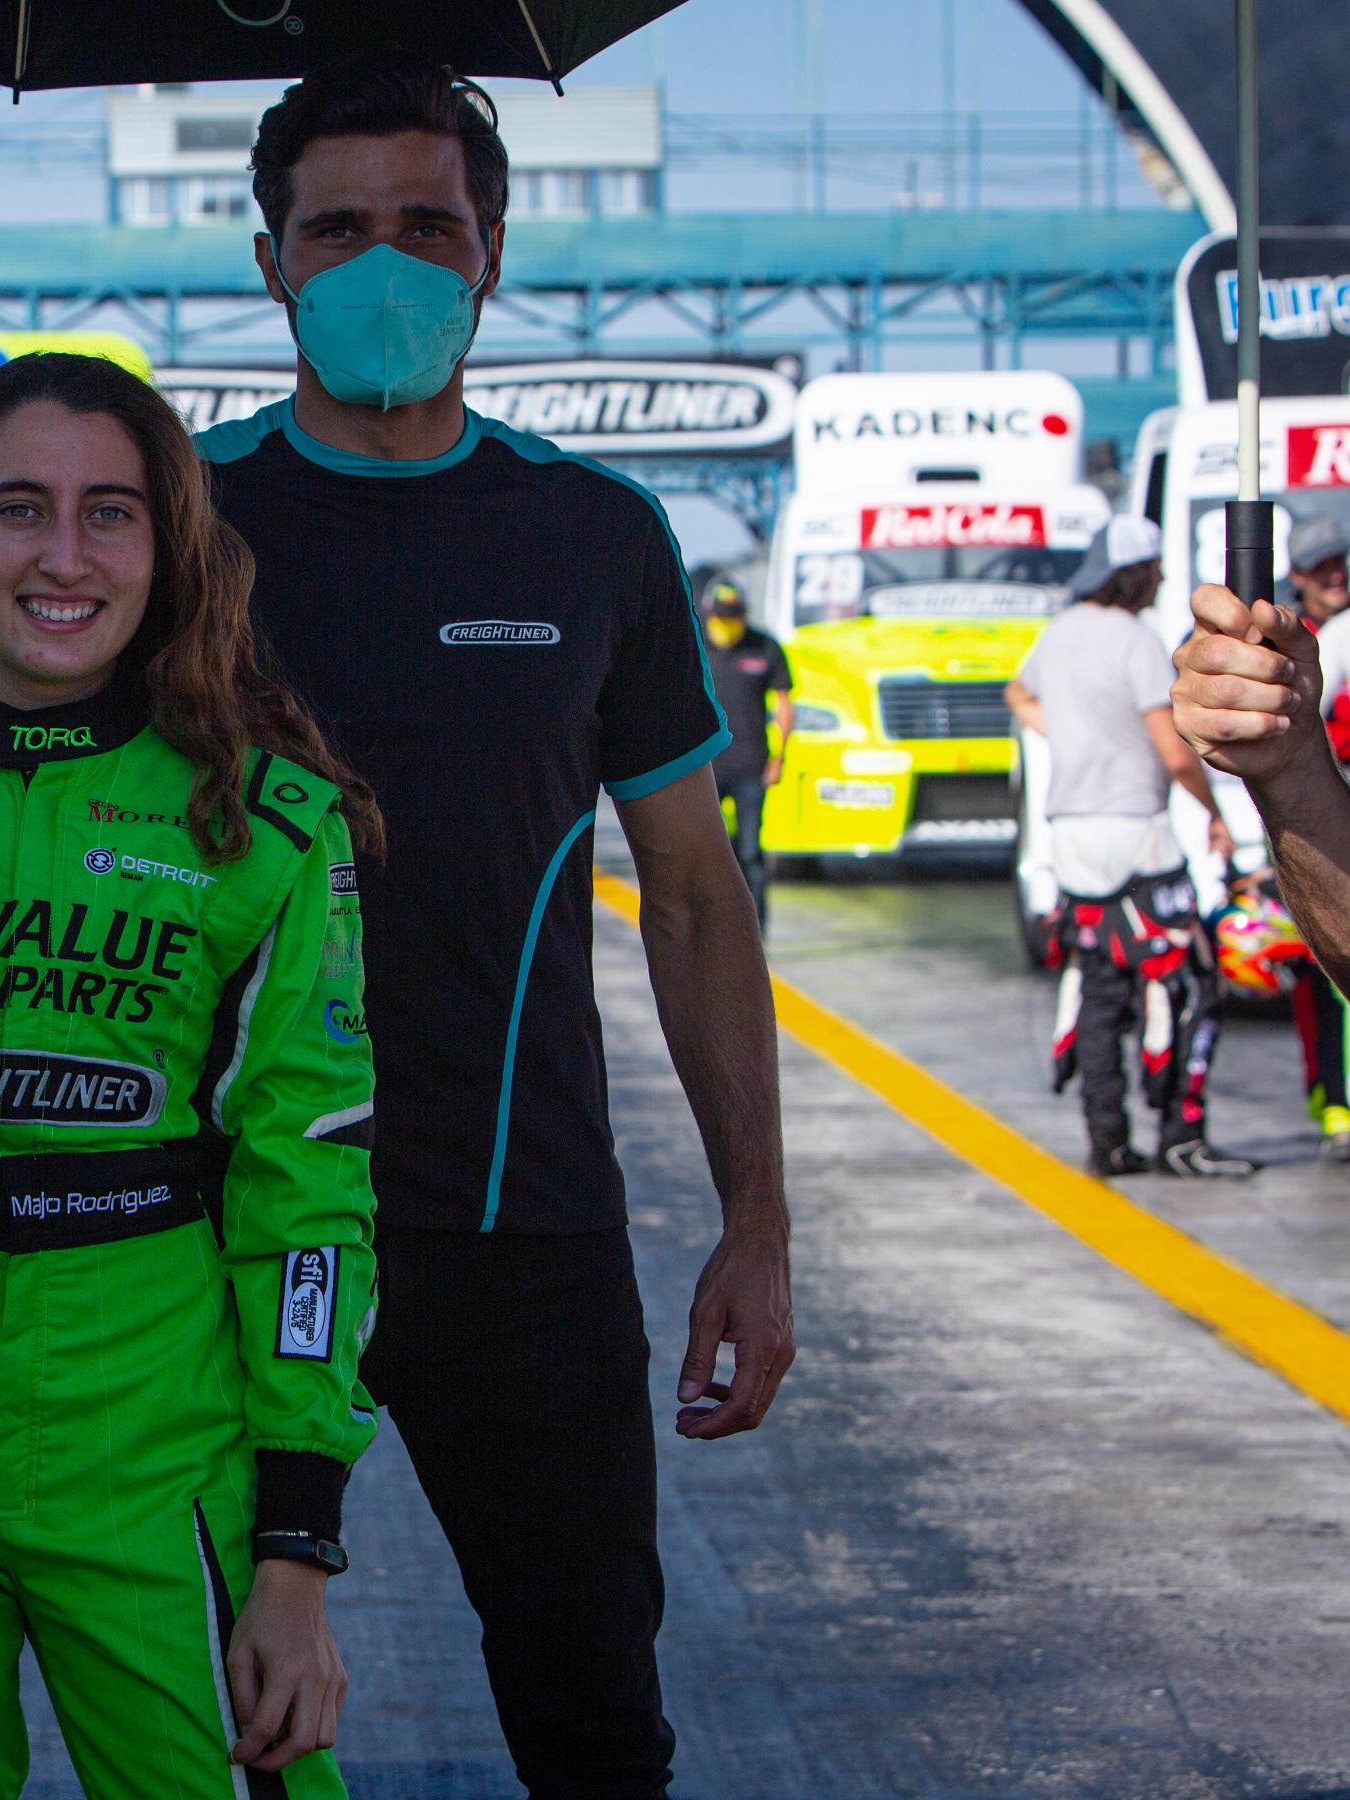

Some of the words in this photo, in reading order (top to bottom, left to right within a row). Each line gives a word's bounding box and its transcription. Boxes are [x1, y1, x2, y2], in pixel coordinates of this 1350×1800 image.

[451, 625, 550, 640] FREIGHTLINER
[9, 726, 98, 751] TORQ
[121, 854, 219, 889] DETROIT
[11, 1193, 62, 1219] Majo
[300, 1253, 323, 1282] sfi
[298, 1296, 309, 1332] CERTIFIED
[305, 1287, 318, 1342] MANUFACTURER
